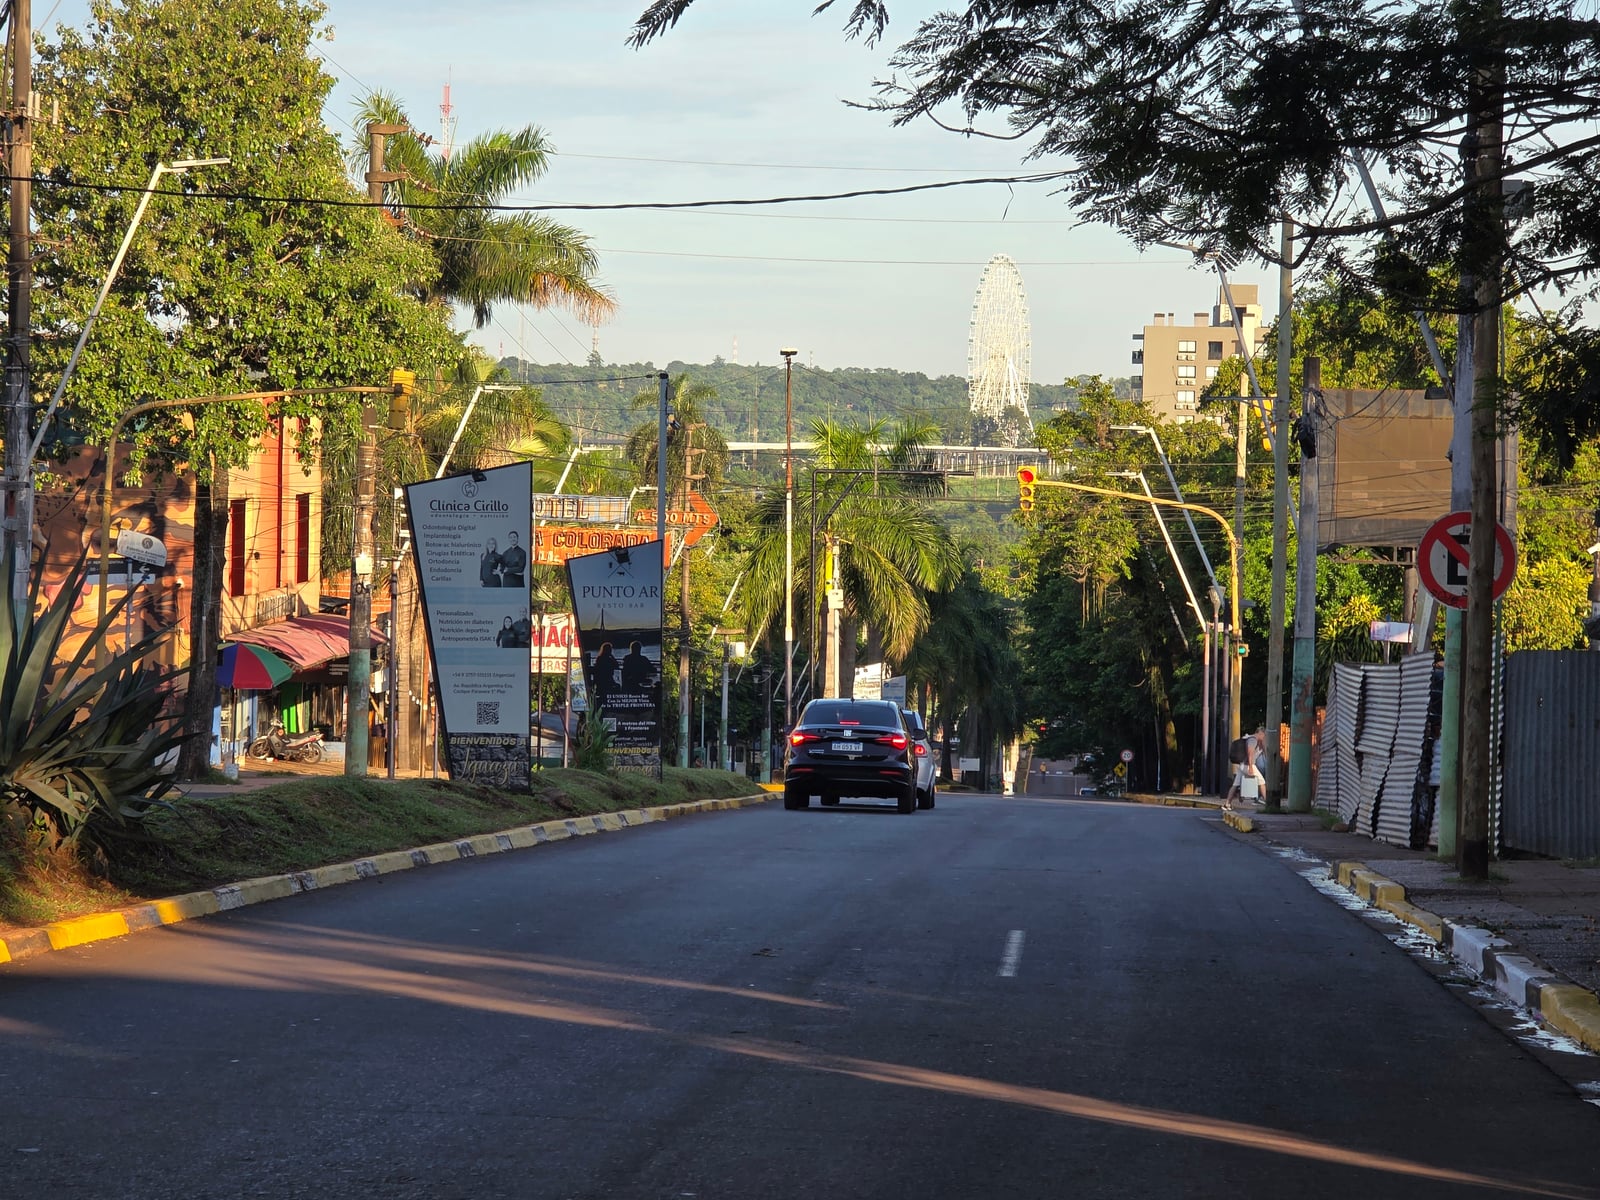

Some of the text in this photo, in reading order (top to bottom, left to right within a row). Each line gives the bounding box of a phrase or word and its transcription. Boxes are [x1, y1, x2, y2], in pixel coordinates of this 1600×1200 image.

[474, 500, 509, 511] Cirillo
[534, 497, 589, 518] OTEL
[683, 513, 710, 524] MTS
[582, 586, 660, 598] PUNTO AR
[449, 736, 526, 746] BIENVENIDOS A
